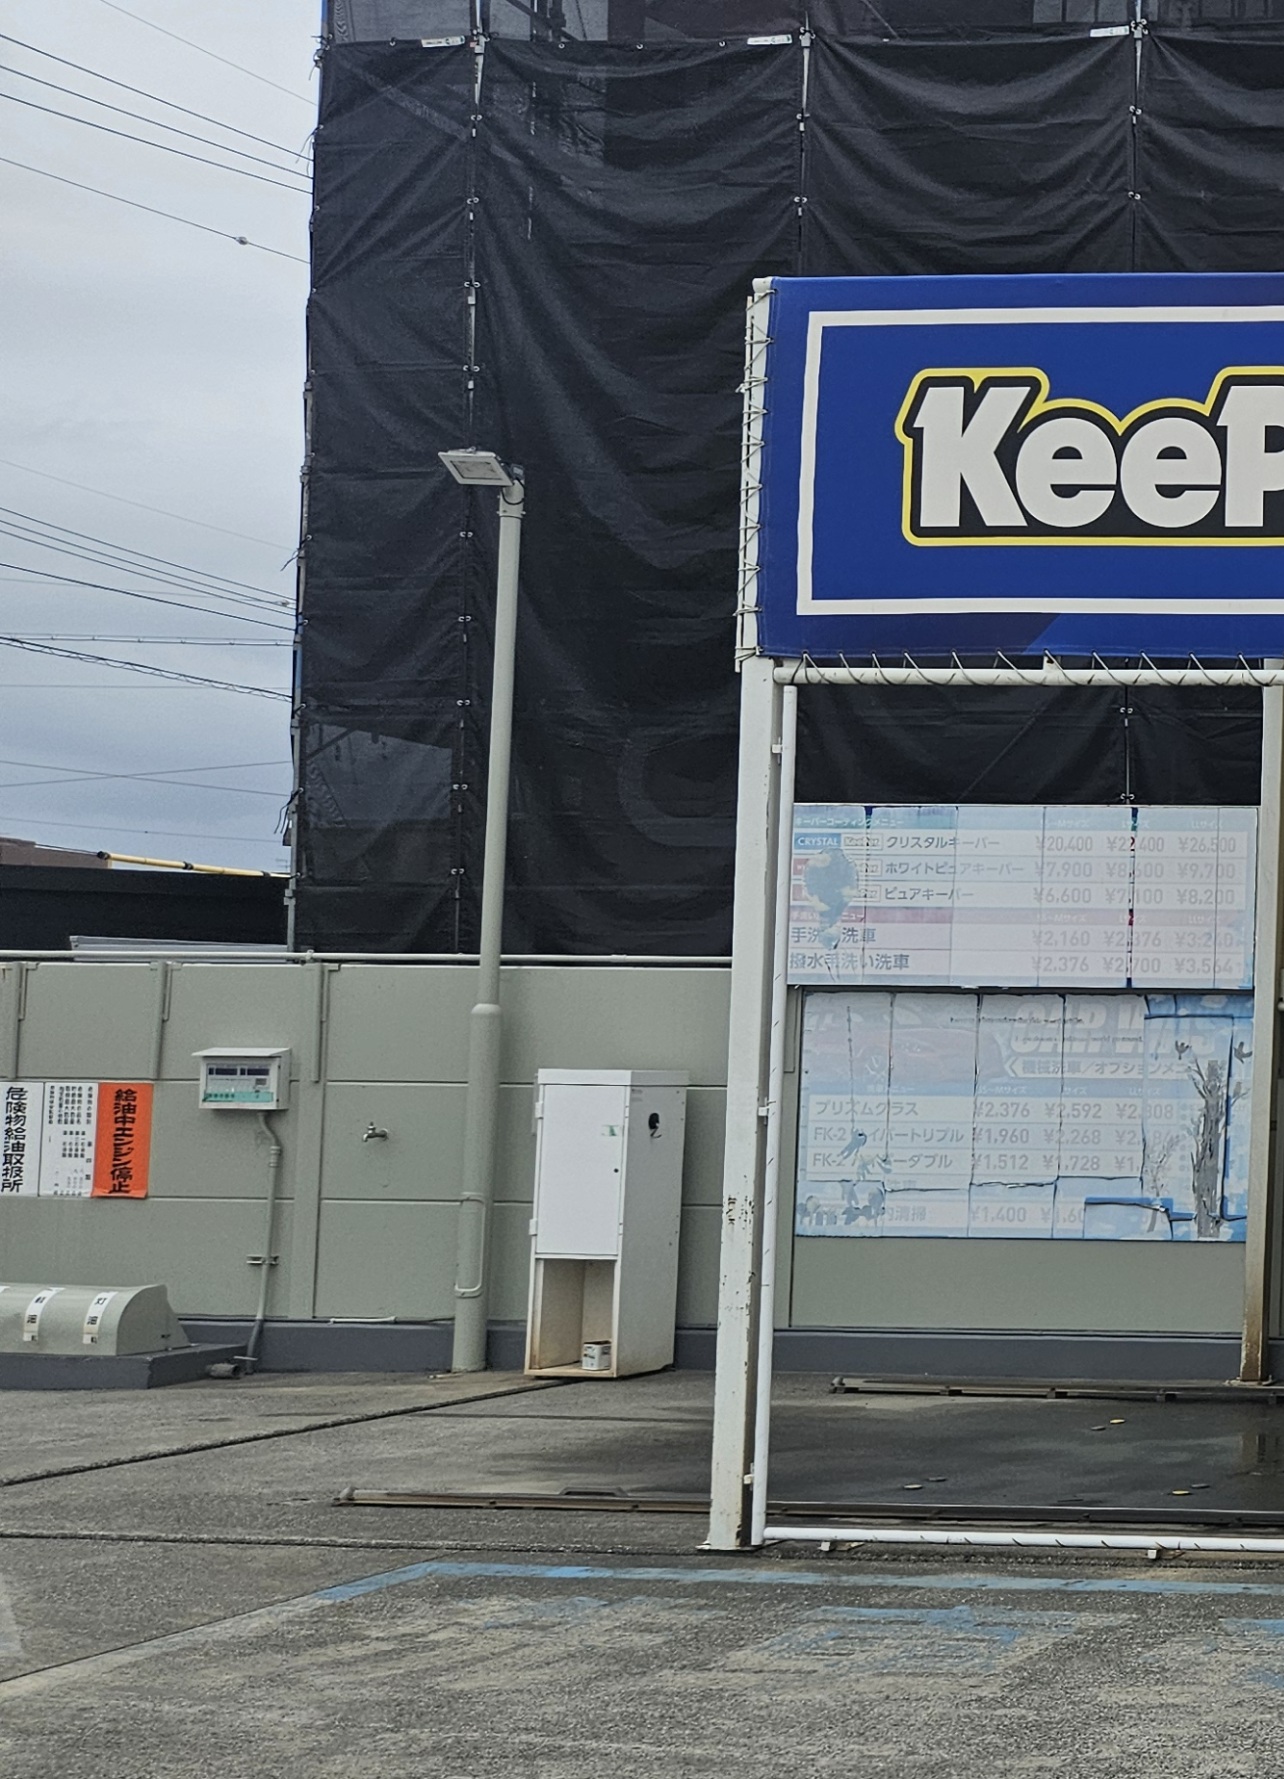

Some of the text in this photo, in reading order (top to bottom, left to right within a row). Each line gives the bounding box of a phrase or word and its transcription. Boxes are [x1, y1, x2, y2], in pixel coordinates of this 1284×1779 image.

[798, 837, 838, 846] CRYSTAL
[1, 1086, 28, 1193] 危険物給油取扱所
[108, 1088, 138, 1194] 給油中エンジン停止
